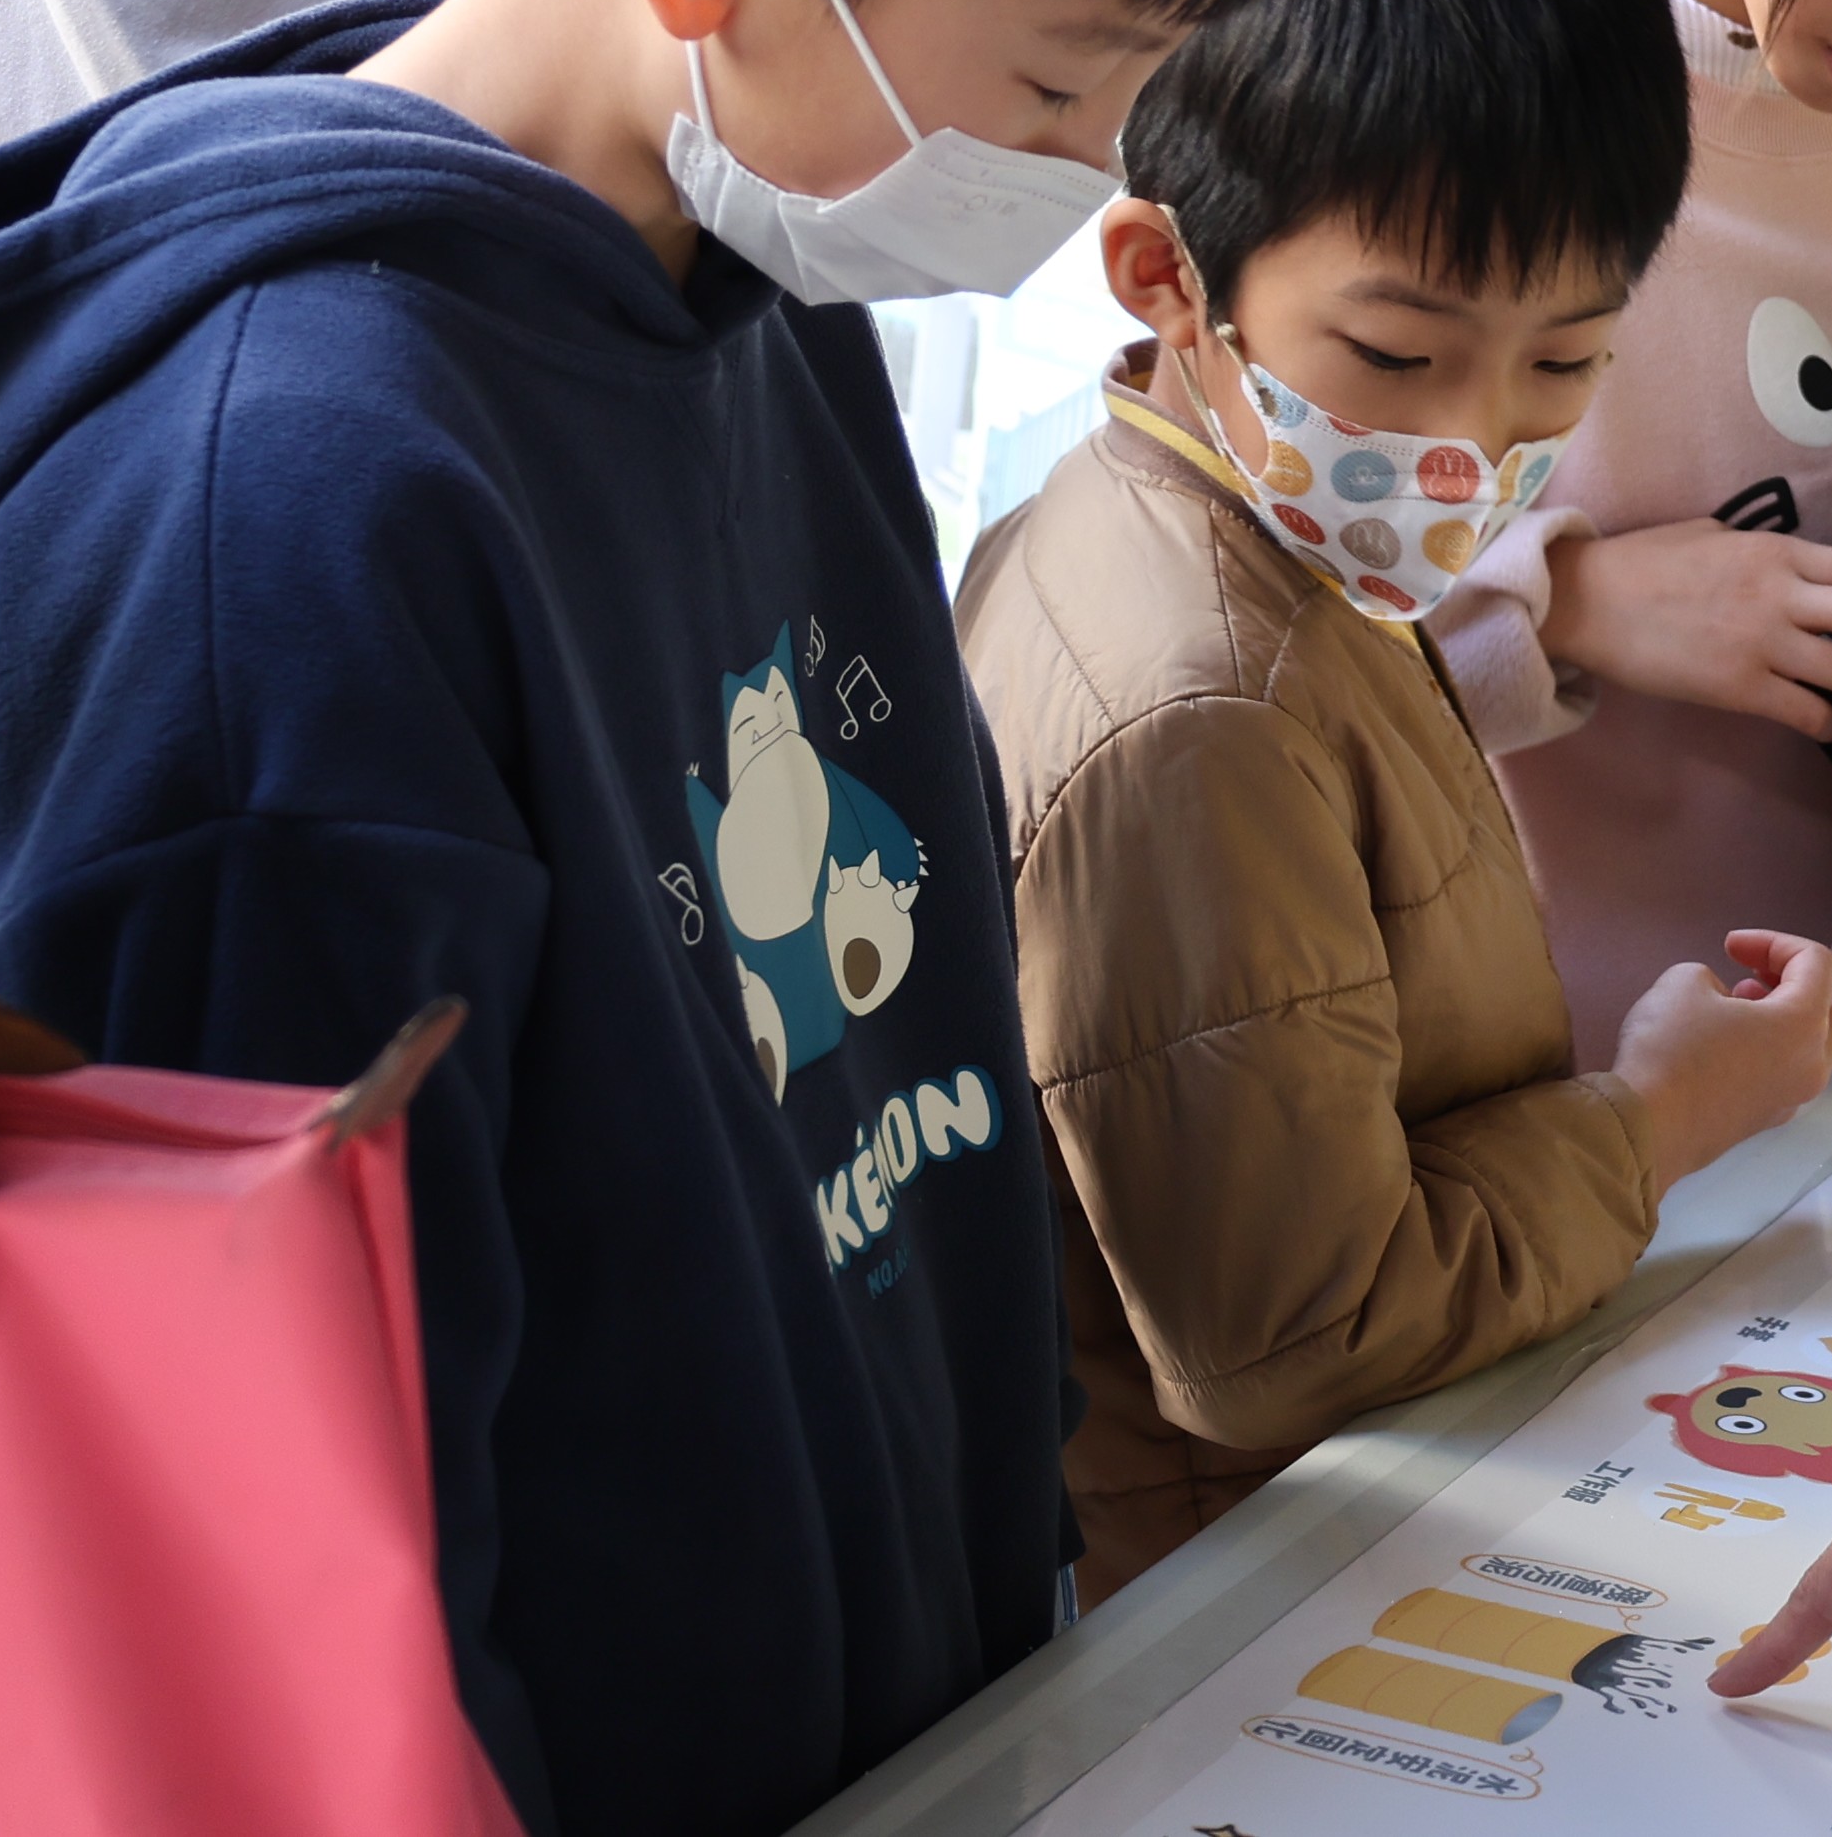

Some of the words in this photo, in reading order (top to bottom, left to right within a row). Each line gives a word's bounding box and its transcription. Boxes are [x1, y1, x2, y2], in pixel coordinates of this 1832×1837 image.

[1736, 1315, 1791, 1343] 手套
[1560, 1460, 1636, 1505] 工作服
[1479, 1555, 1654, 1606] 殘渣污泥
[1252, 1720, 1520, 1796] 水泥安定固化
